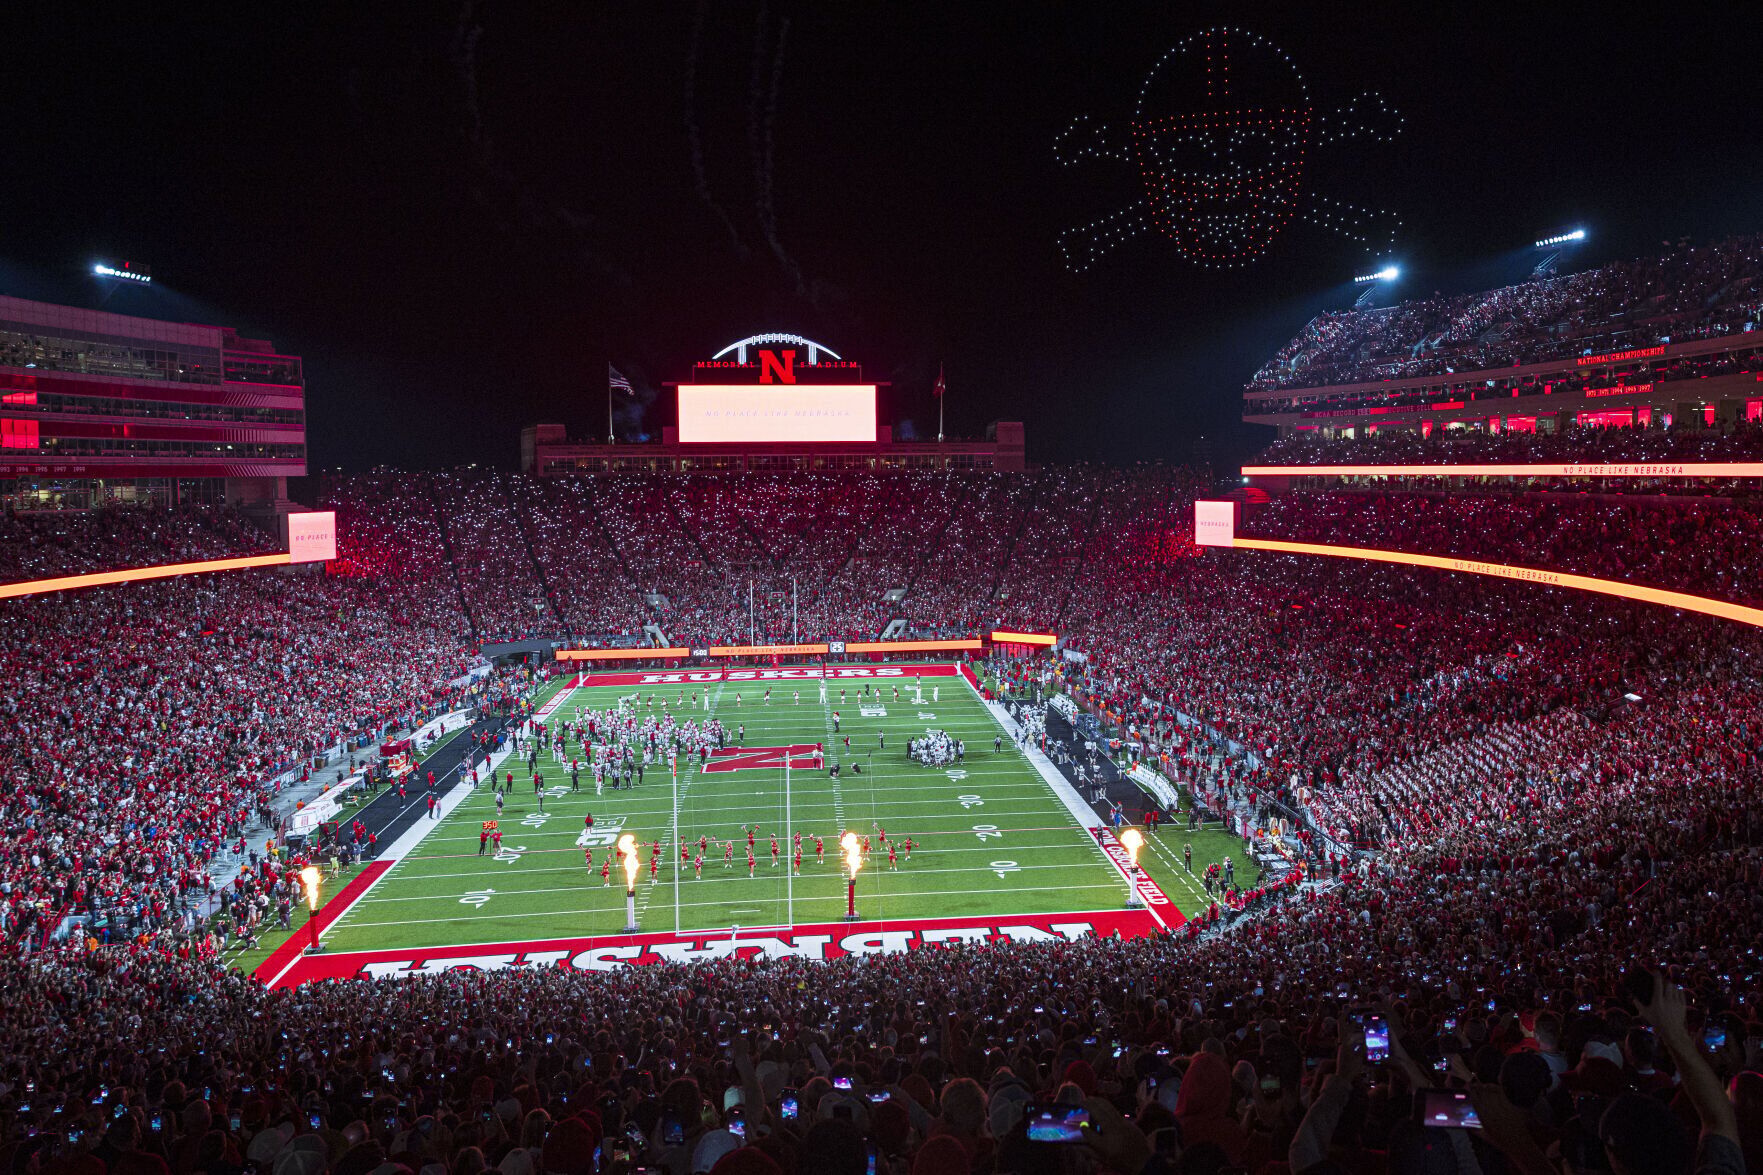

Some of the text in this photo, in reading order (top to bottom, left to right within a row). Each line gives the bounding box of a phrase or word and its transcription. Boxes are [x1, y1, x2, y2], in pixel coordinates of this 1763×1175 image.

[1577, 346, 1665, 366] NATIONAL CHAMPIONSHIPS
[758, 350, 797, 384] N
[705, 409, 720, 417] NO
[1563, 466, 1683, 474] NO PLACE LIKE NEBRASKA
[307, 533, 329, 541] PLACE
[1454, 561, 1559, 583] NO PLACE LIKE NEBRASKA
[832, 643, 843, 652] 25
[639, 667, 904, 683] HUSKERS
[519, 812, 552, 827] 30
[972, 824, 1003, 839] 20
[492, 846, 527, 861] 20
[989, 860, 1022, 874] 10
[458, 888, 497, 904] 10
[1136, 880, 1169, 905] FIELD
